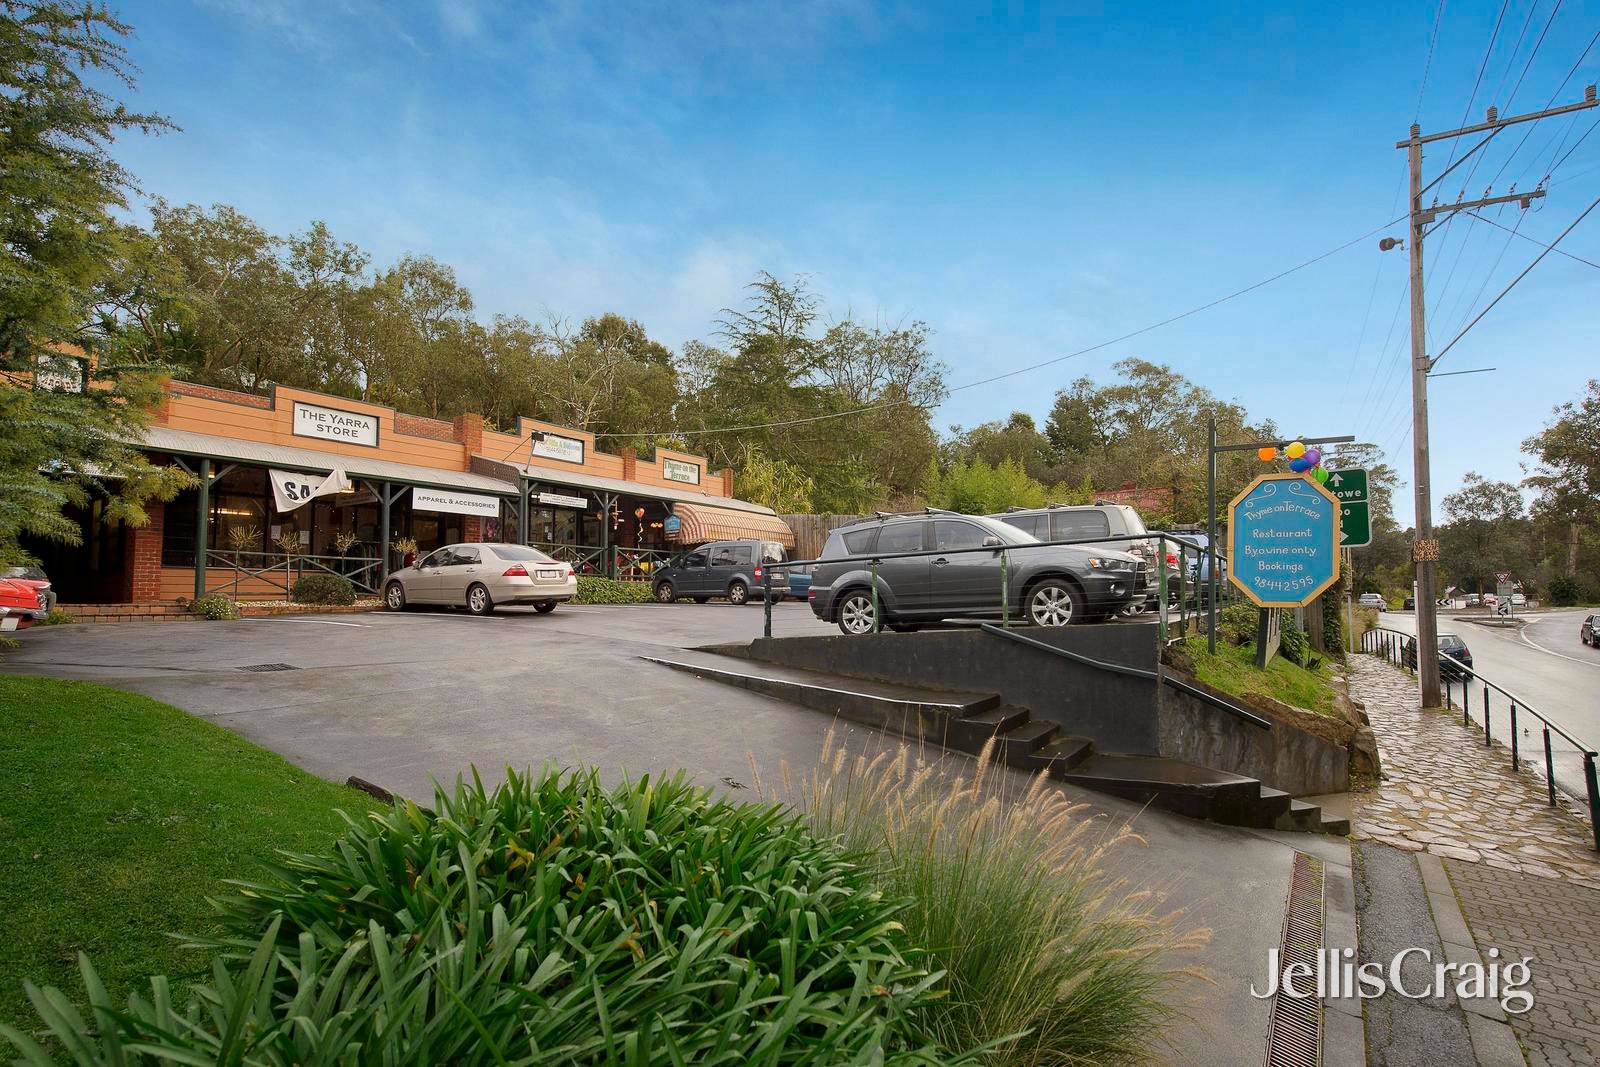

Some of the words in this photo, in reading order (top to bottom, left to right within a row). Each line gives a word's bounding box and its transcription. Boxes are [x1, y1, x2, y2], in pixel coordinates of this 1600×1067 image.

[299, 408, 327, 422] THE
[329, 413, 370, 430] YARRA
[316, 423, 359, 438] STORE
[284, 481, 320, 501] SA
[417, 495, 448, 504] APPAREL
[454, 499, 497, 510] ACCESSORIES
[1243, 504, 1274, 521] Thyme
[1274, 504, 1285, 512] on
[1282, 500, 1321, 520] Terrace
[1252, 528, 1313, 539] Restaurant
[1291, 545, 1317, 557] only
[1258, 560, 1304, 574] Bookings
[1254, 575, 1315, 592] 98442595
